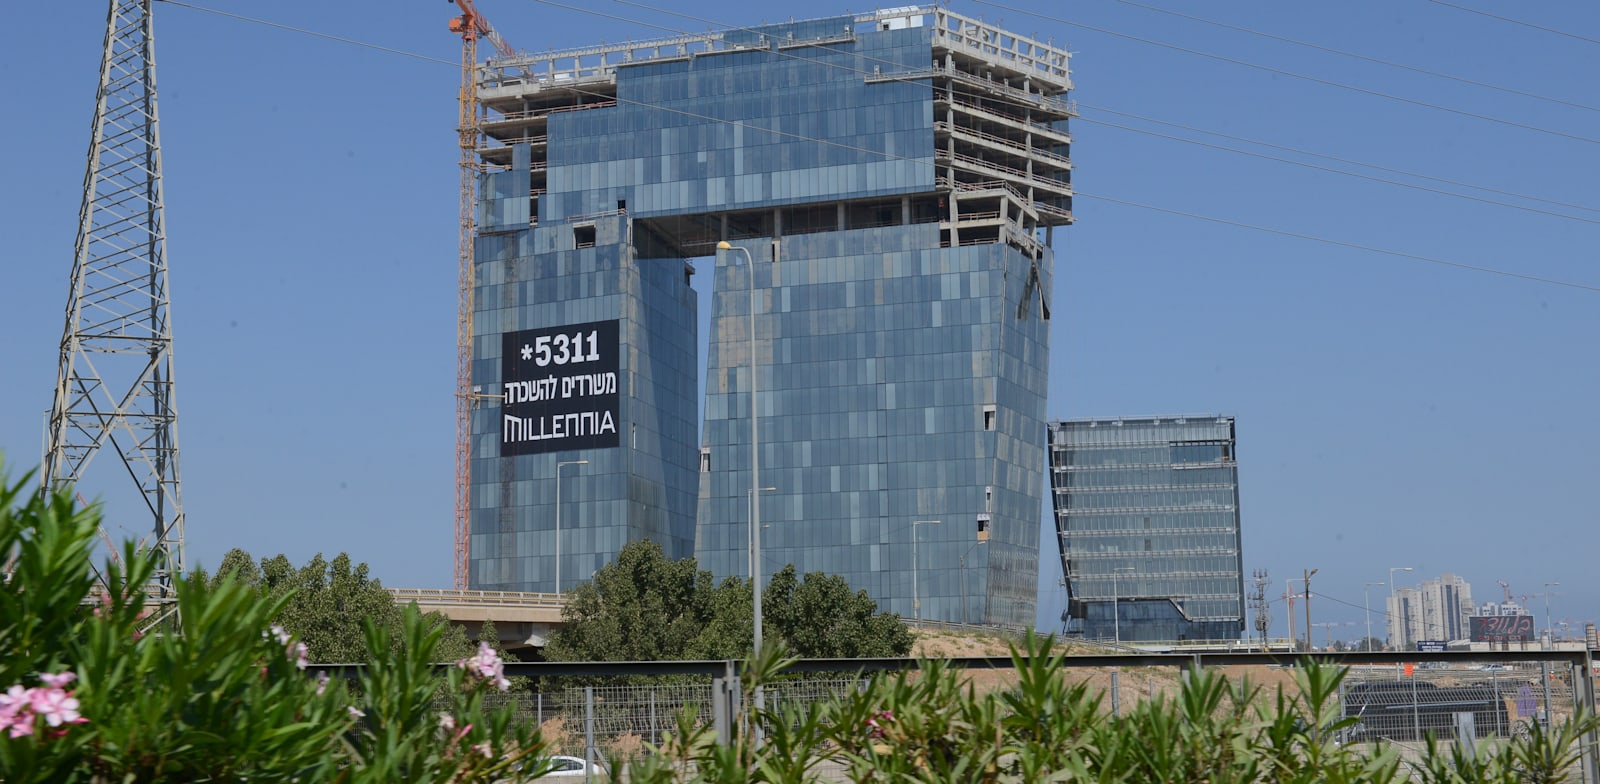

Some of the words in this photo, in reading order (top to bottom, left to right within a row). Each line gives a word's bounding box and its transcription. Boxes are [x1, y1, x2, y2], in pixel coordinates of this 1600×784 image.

[504, 374, 558, 405] להשכרה
[562, 372, 617, 399] משרדים
[504, 410, 617, 443] MILLENNIA
